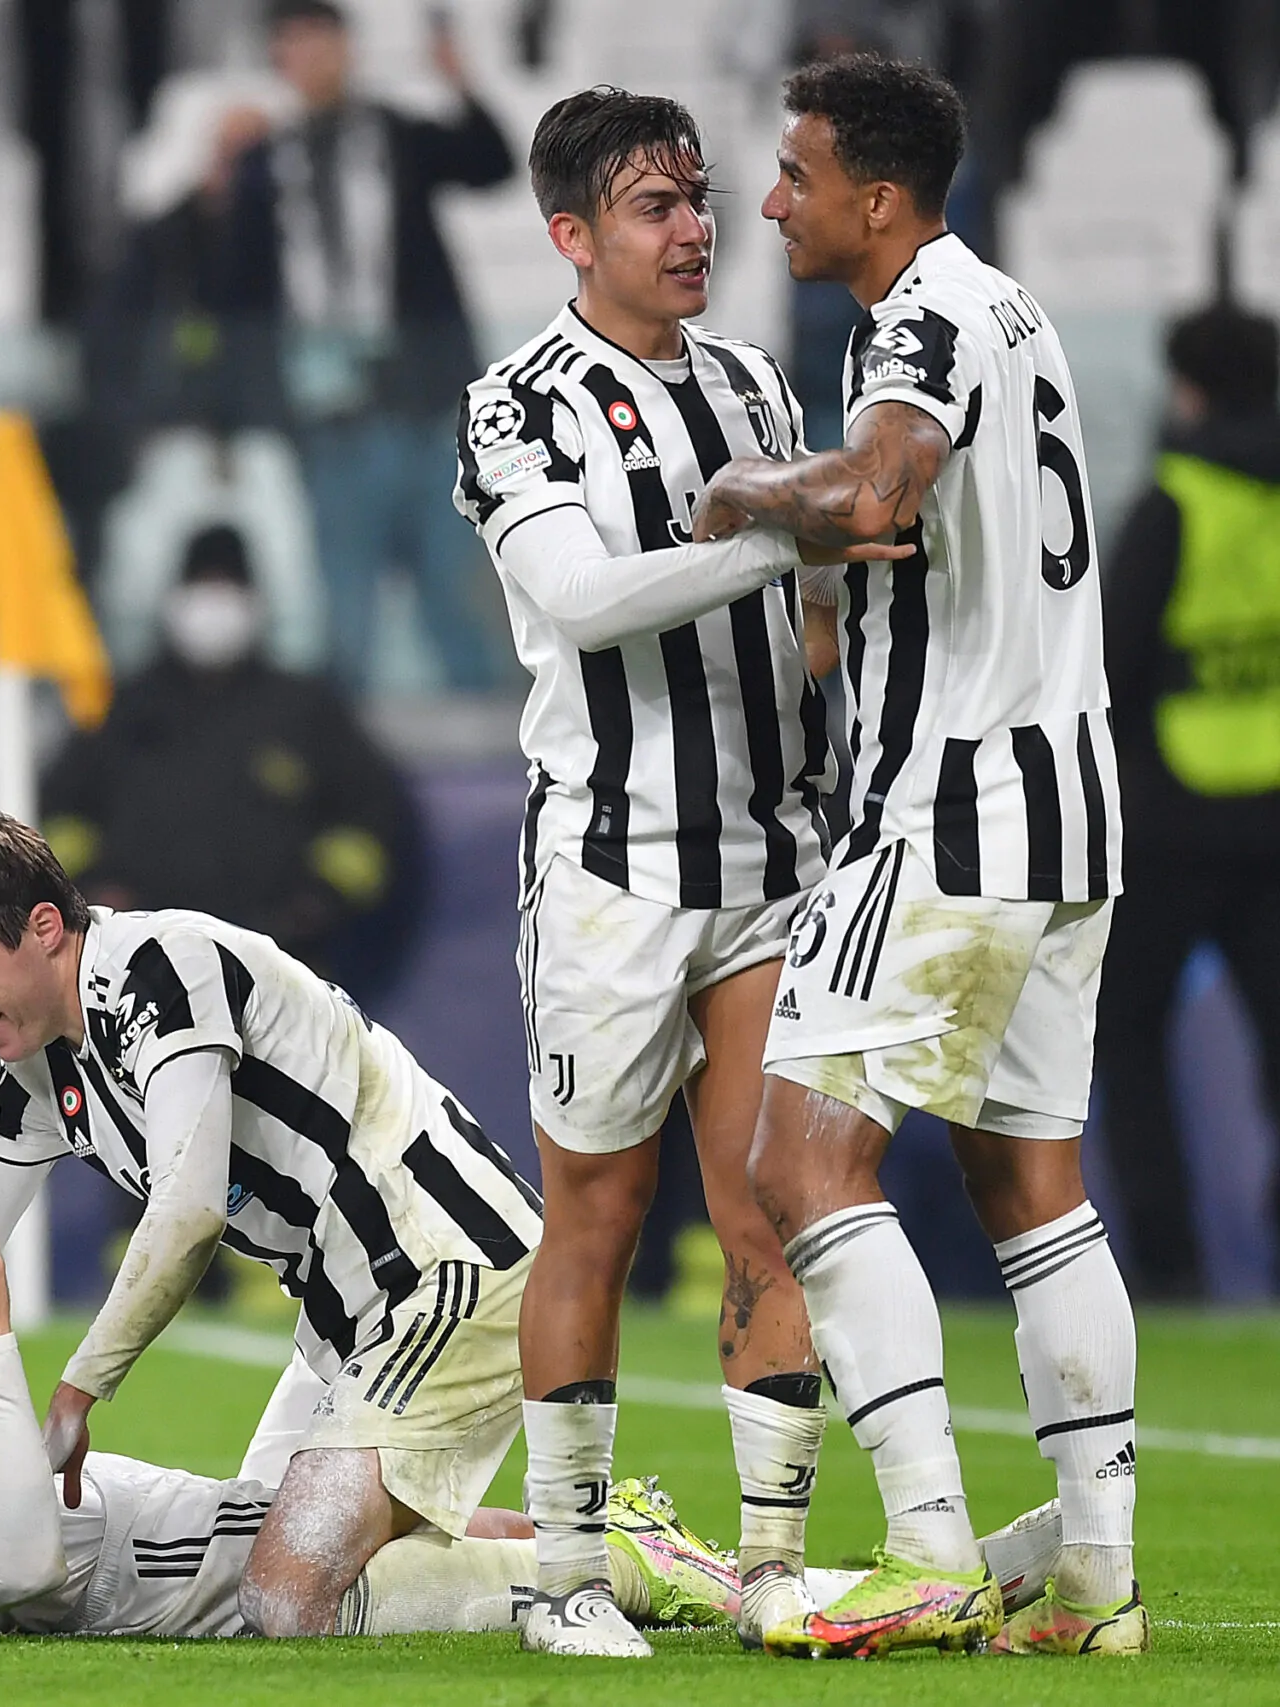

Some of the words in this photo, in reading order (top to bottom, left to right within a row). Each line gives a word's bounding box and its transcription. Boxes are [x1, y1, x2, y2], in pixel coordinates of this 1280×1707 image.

[622, 456, 661, 471] adidas
[1033, 374, 1090, 591] 6
[789, 889, 836, 969] 6
